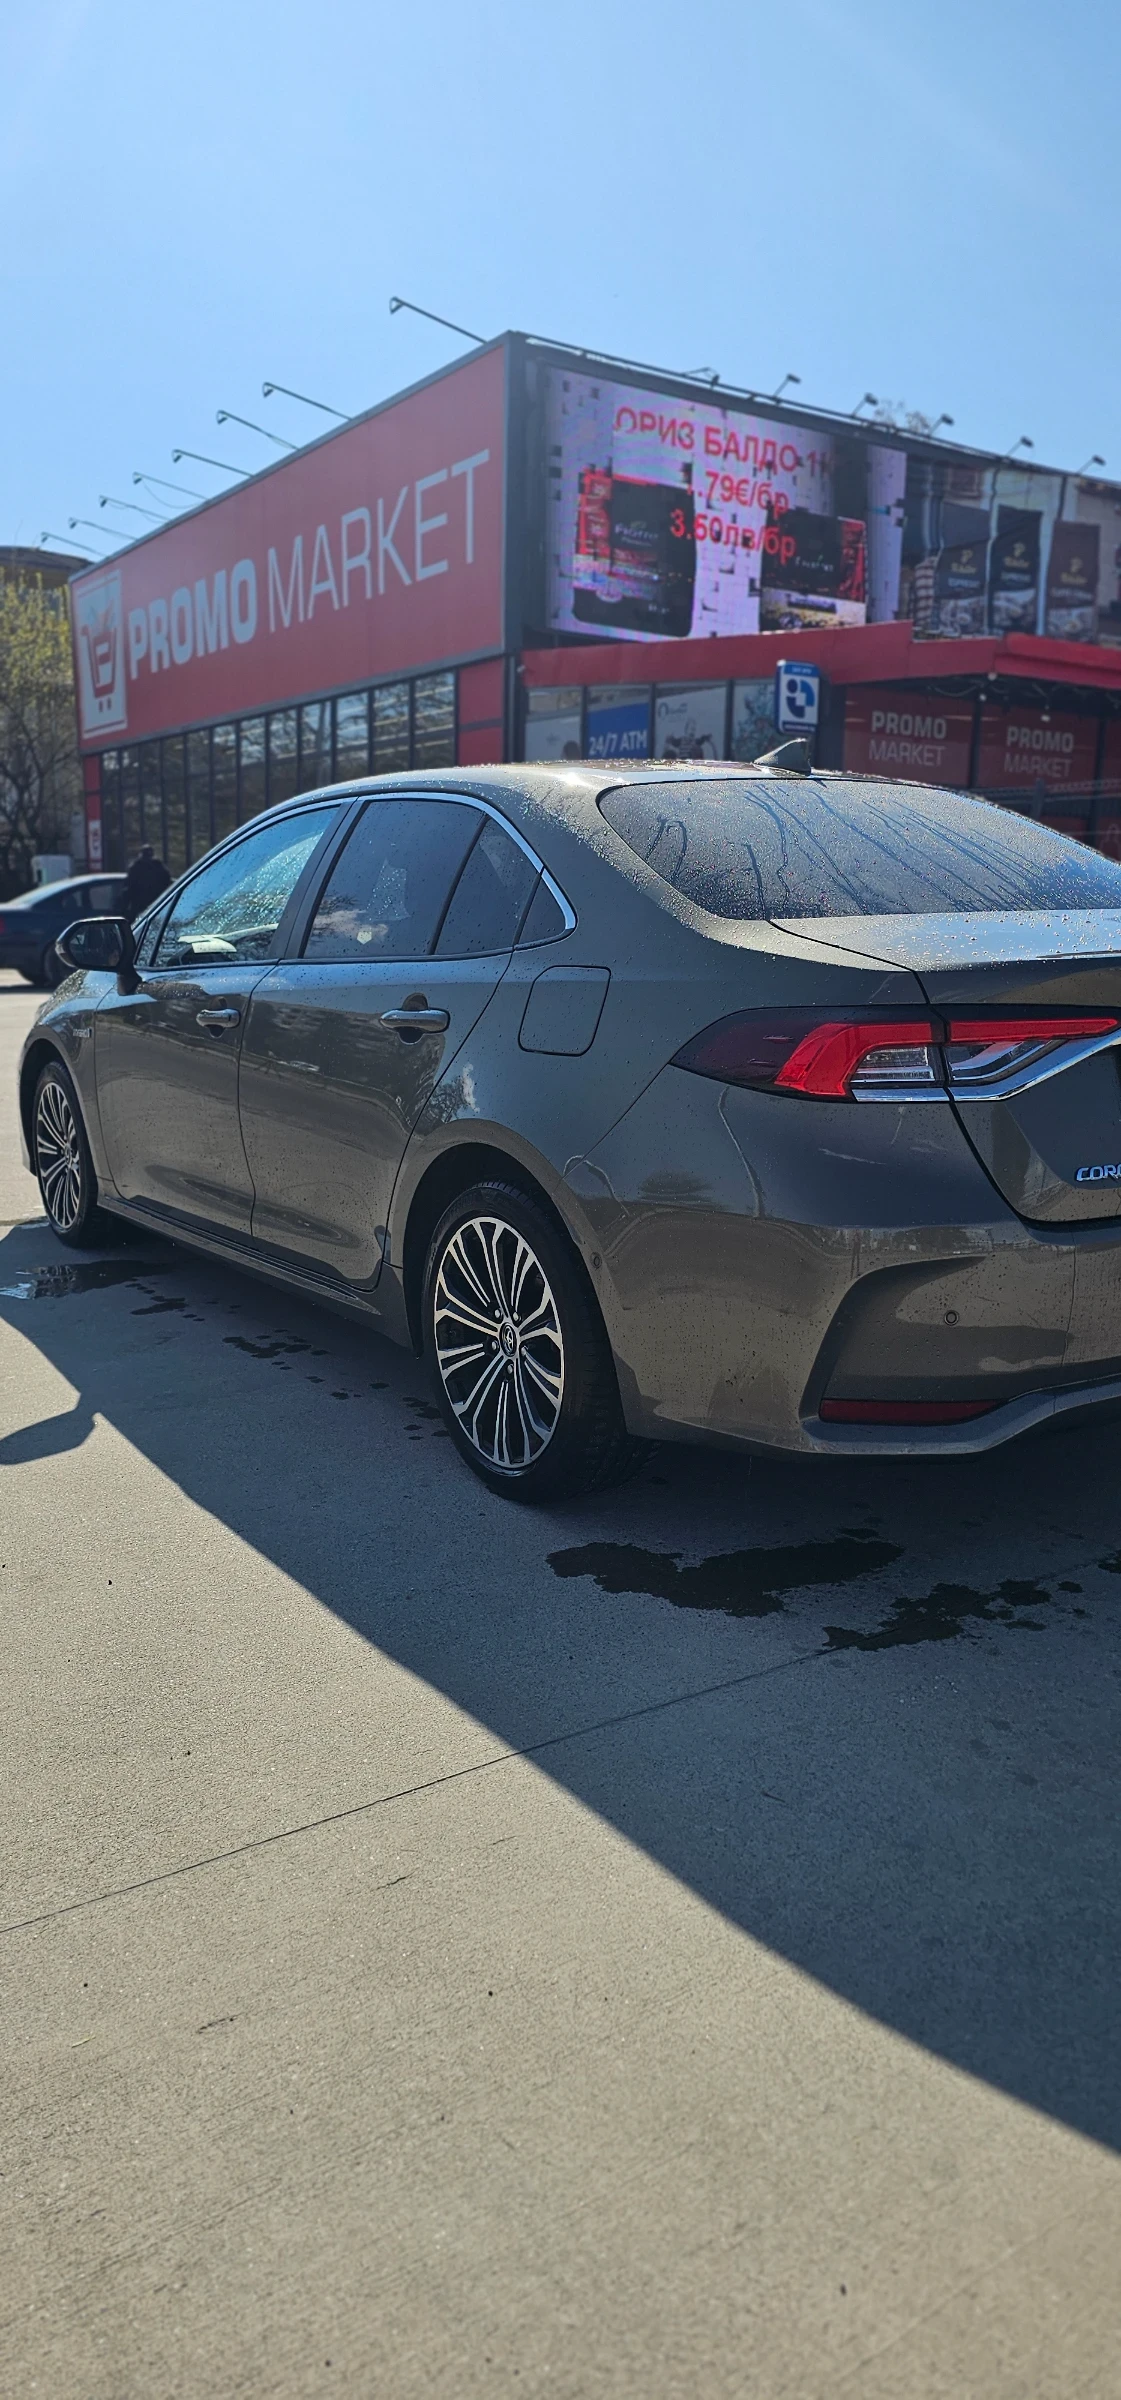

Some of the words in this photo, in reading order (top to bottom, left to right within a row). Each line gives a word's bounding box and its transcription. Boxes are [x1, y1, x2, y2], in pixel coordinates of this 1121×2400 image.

[614, 407, 695, 450] ОРИЗ
[704, 427, 798, 475] БАЛДО
[128, 558, 258, 680] PROMO
[267, 448, 490, 633] MARKET
[871, 711, 947, 739] PROMO
[589, 732, 617, 755] 24/7
[621, 730, 648, 751] ATM
[868, 739, 945, 767] MARKET
[1006, 726, 1074, 753] PROMO
[1004, 753, 1073, 778] MARKET
